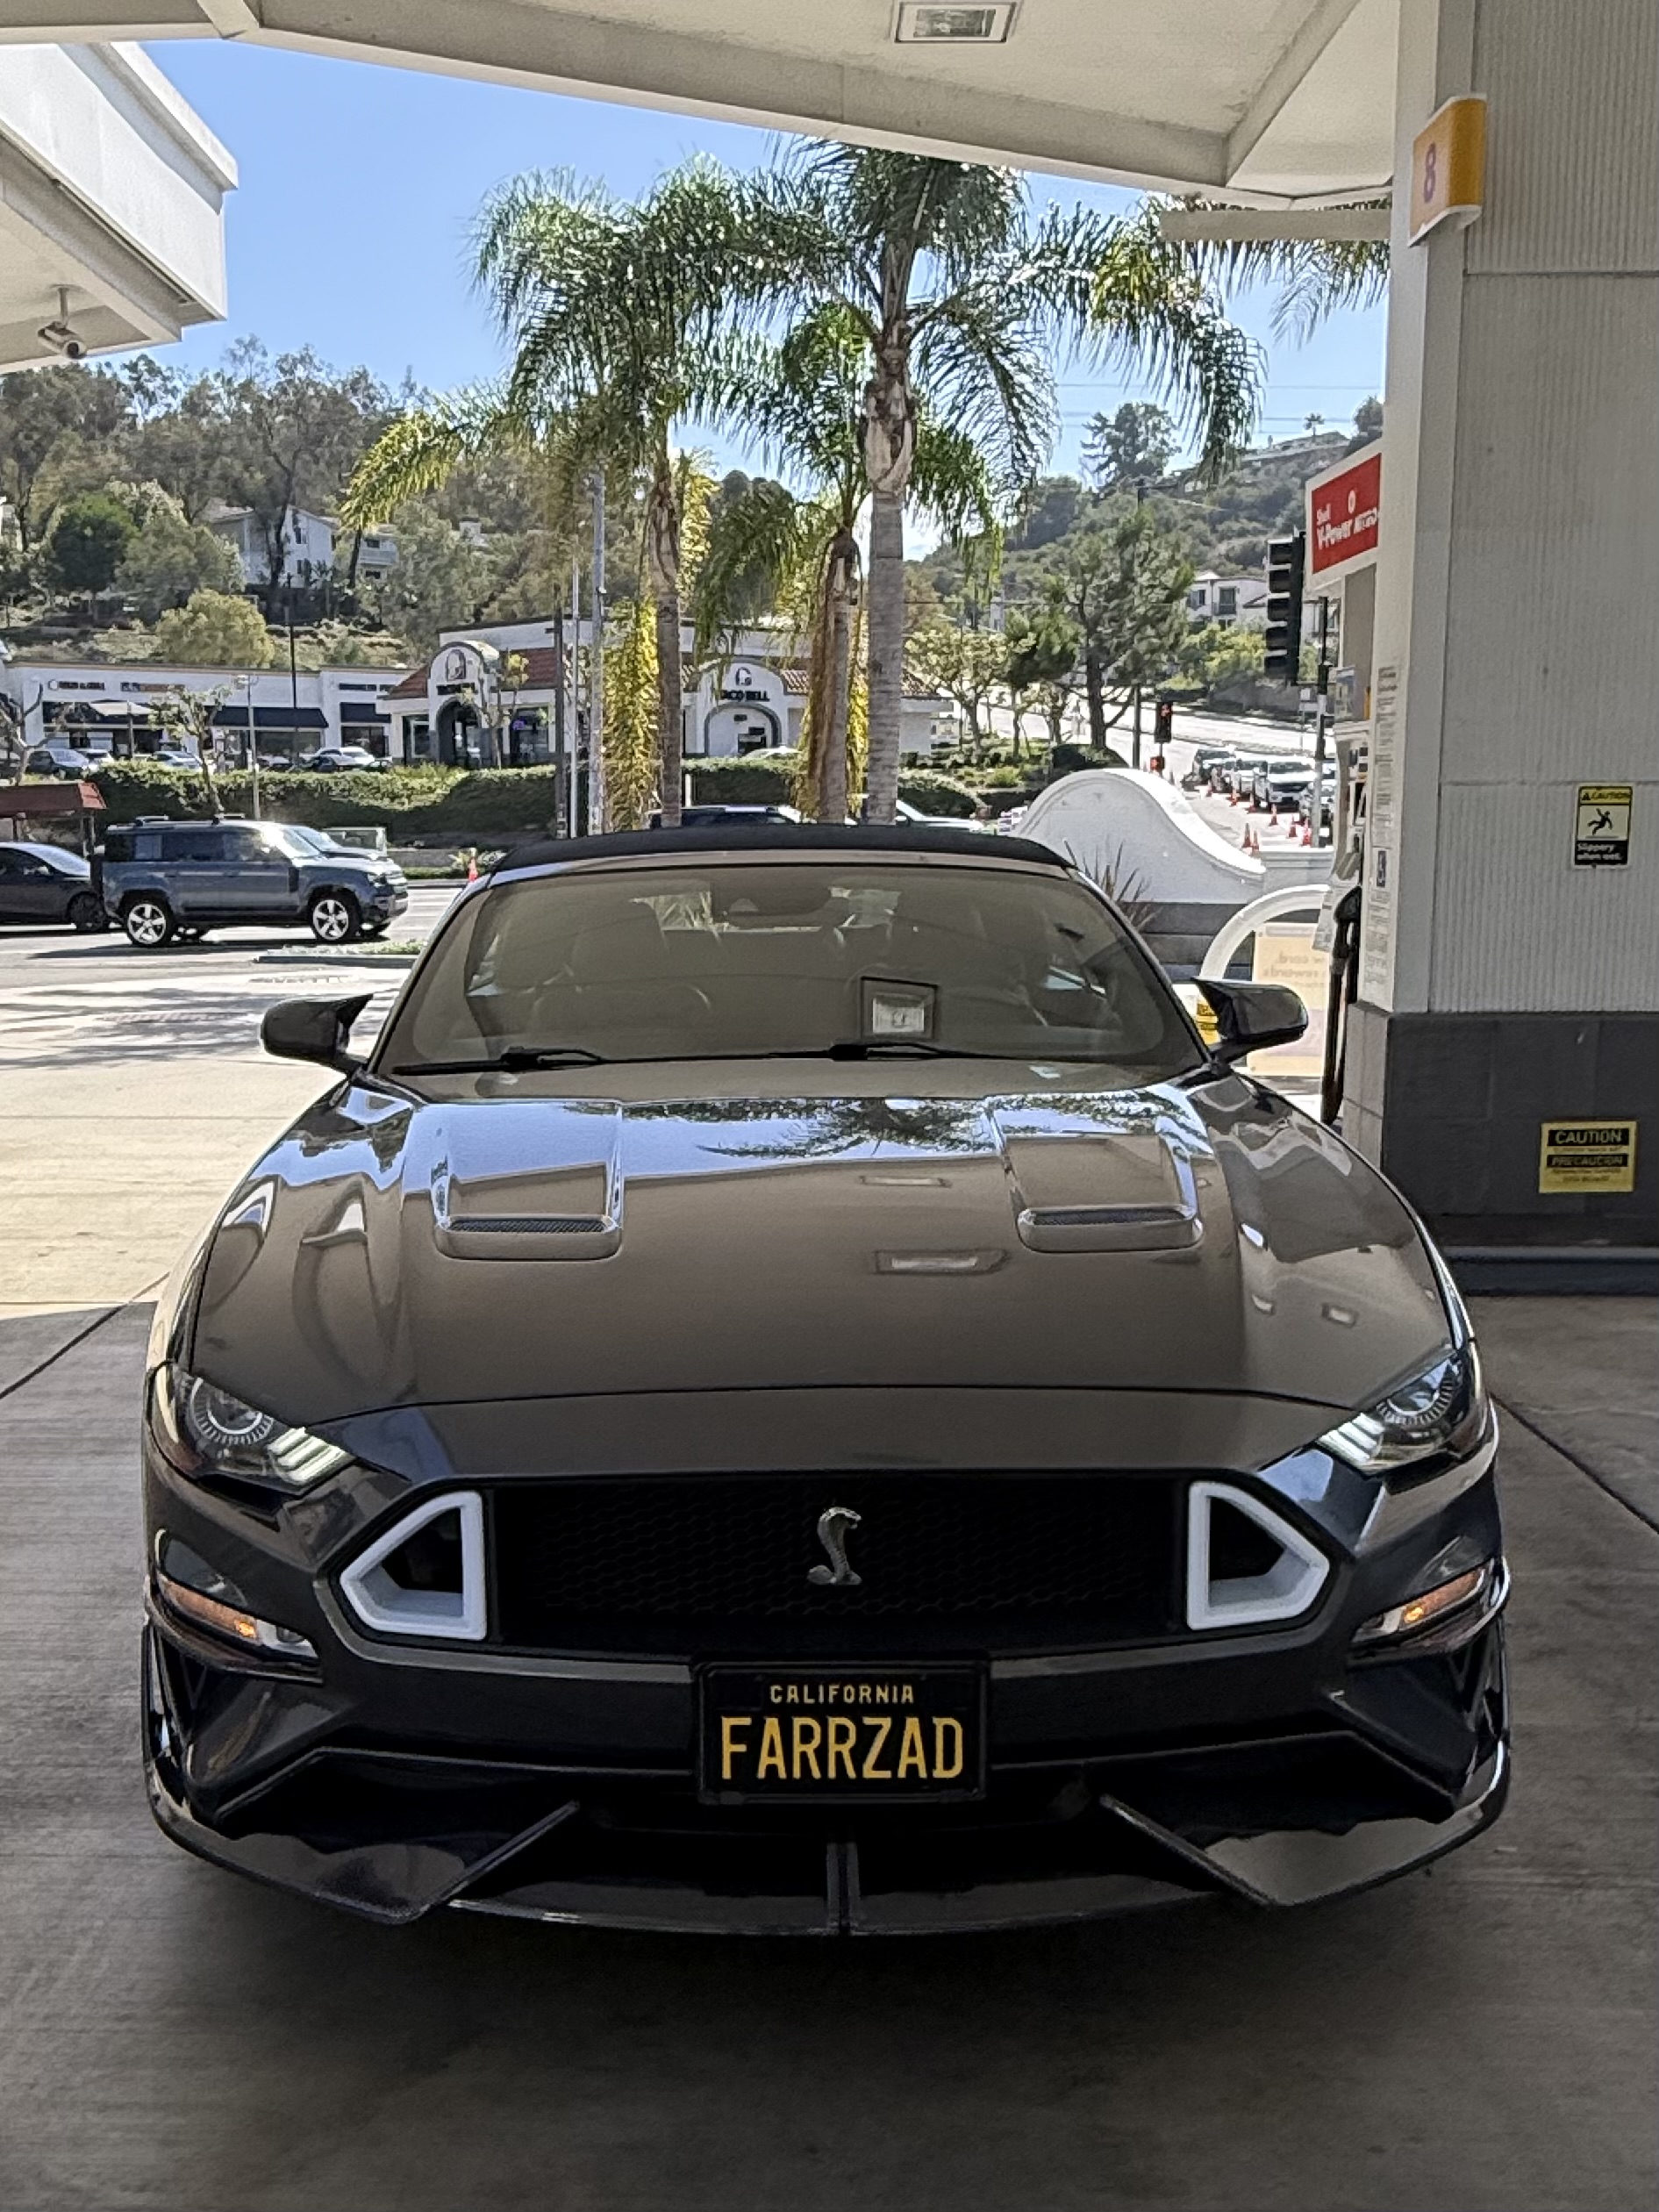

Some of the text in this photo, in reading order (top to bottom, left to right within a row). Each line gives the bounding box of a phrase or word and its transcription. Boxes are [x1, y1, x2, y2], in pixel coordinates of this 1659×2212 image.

[1424, 142, 1436, 204] 8
[1555, 1130, 1622, 1143] CAUTION
[769, 1685, 914, 1703] CALIFORNIA
[720, 1715, 964, 1779] FARRZAD
